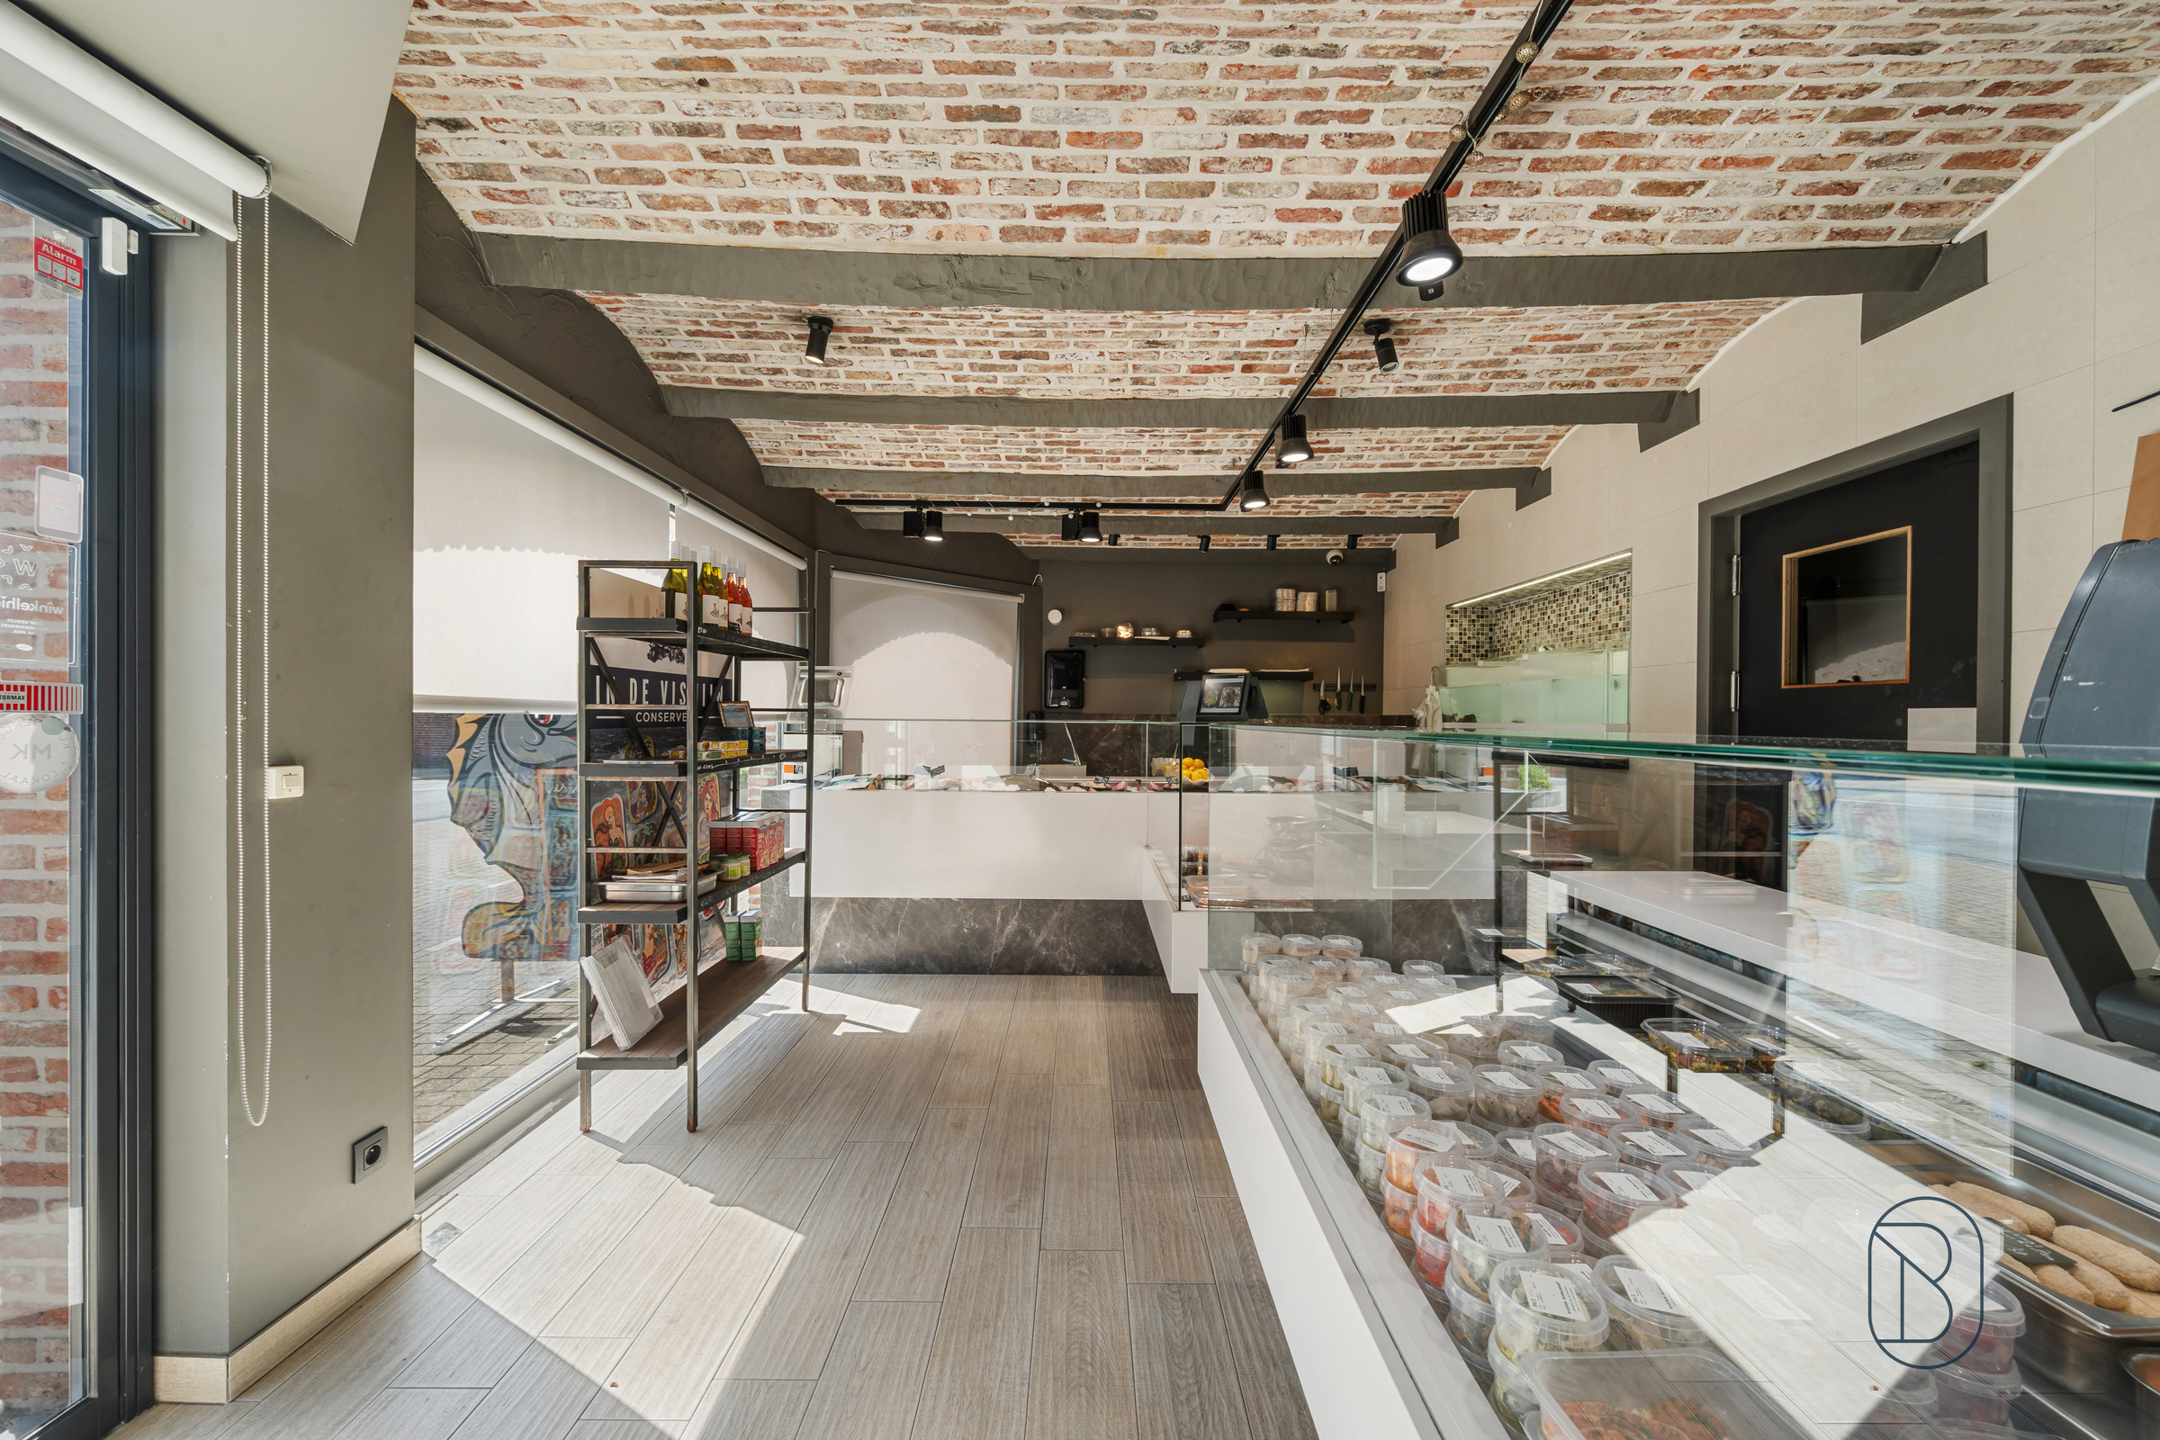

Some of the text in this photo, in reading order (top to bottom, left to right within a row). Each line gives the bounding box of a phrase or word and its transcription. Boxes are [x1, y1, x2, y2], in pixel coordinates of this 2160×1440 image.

[41, 234, 77, 253] verisure
[41, 243, 77, 266] Alarm
[595, 674, 724, 707] IN DE VISIN
[635, 711, 688, 723] CONSERVE
